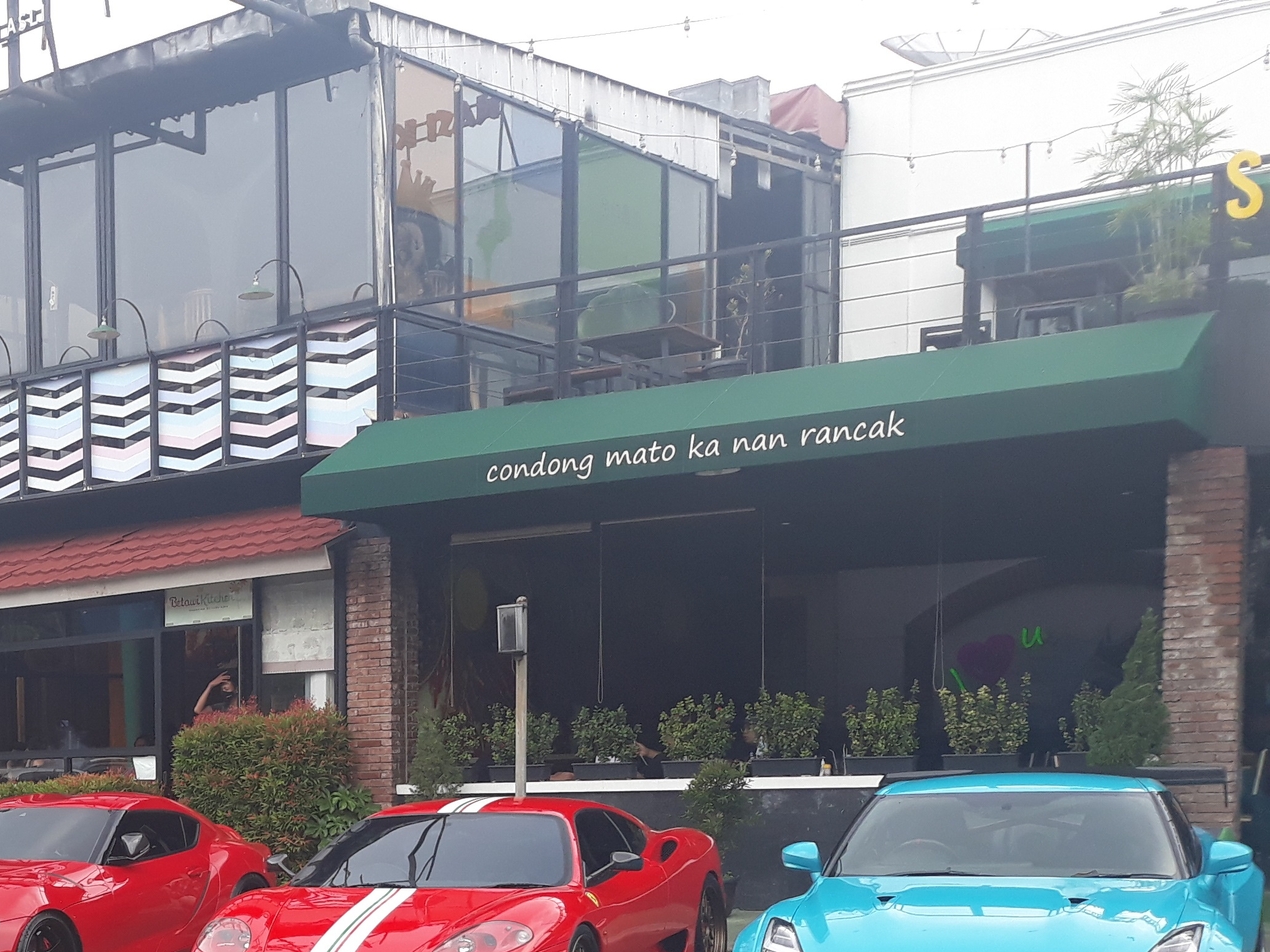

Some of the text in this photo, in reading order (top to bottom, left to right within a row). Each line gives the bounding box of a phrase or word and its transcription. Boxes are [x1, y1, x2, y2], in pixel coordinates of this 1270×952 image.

[486, 409, 906, 483] condong mato ka nan rancak
